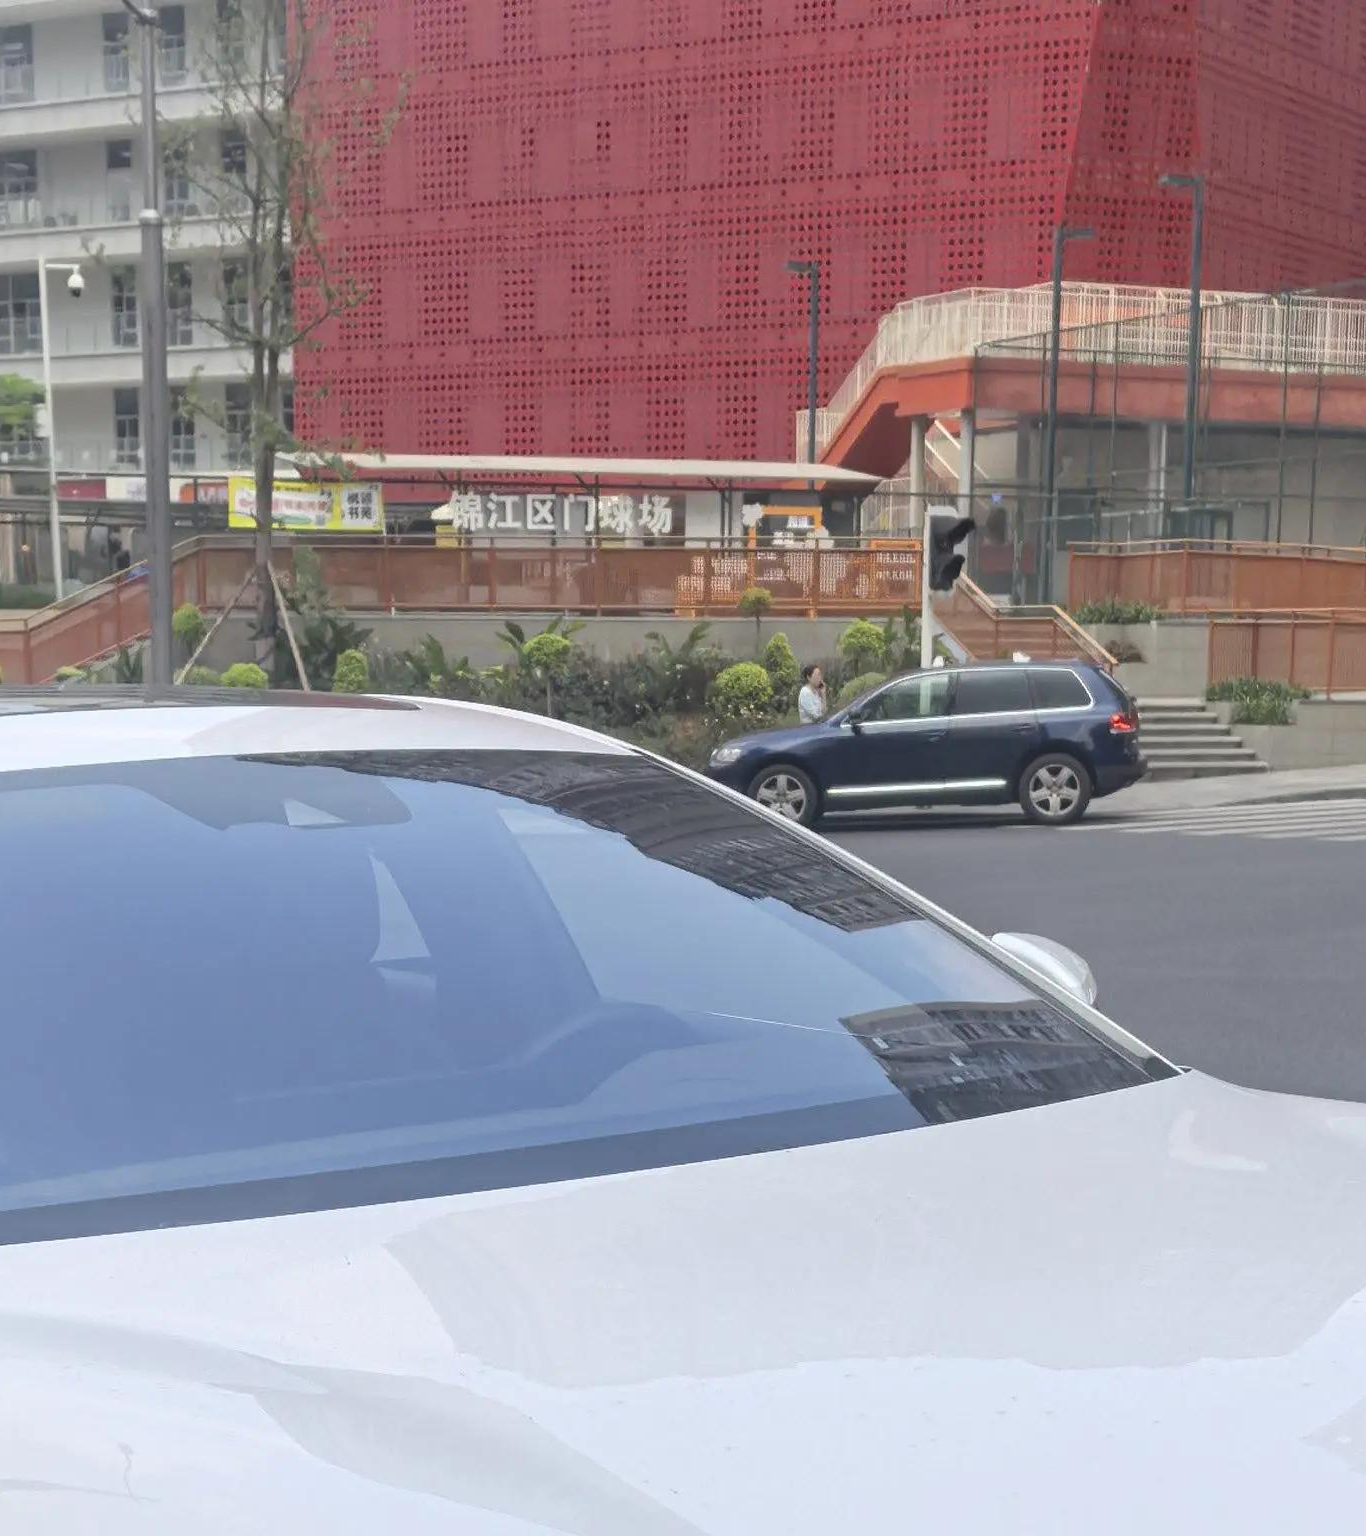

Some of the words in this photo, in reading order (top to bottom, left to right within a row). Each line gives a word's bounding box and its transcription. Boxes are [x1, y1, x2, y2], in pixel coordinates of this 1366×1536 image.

[451, 488, 672, 535] 锦江区门球场
